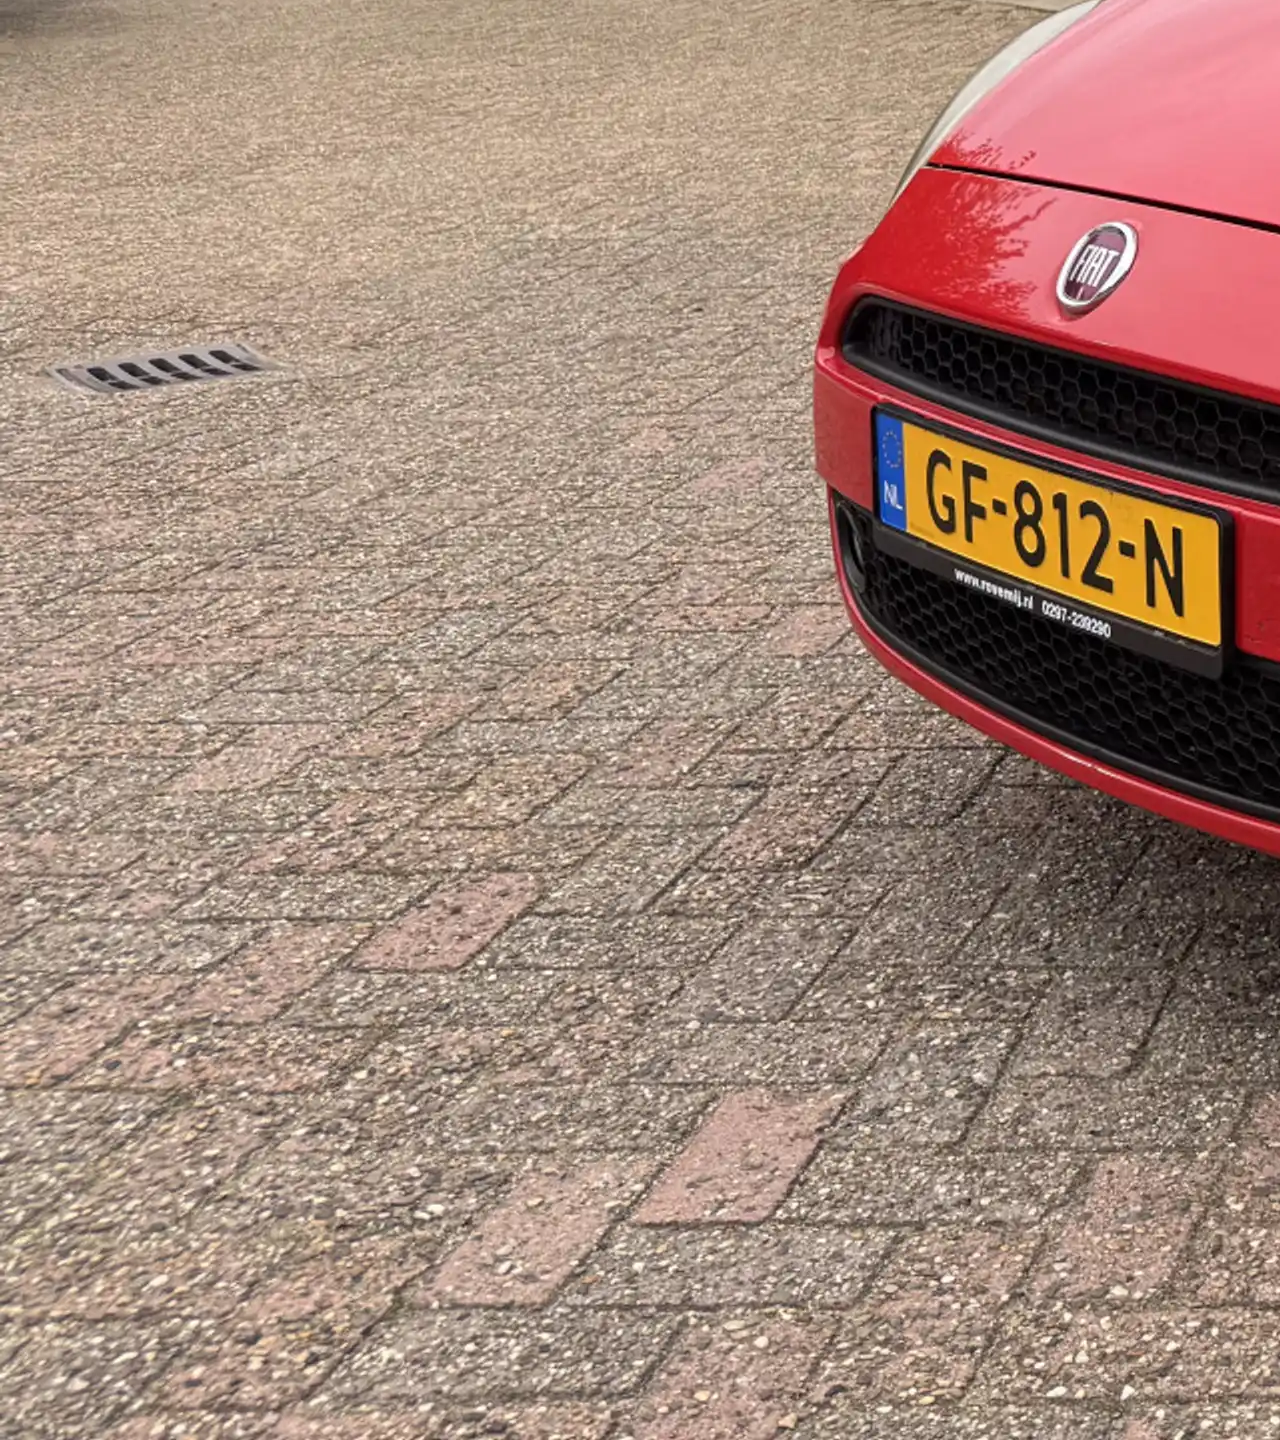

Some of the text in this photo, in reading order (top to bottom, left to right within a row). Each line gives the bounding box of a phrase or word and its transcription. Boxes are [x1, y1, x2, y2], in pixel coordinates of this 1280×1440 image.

[1070, 244, 1121, 288] FIAT
[883, 448, 1185, 618] NL GF-812-N
